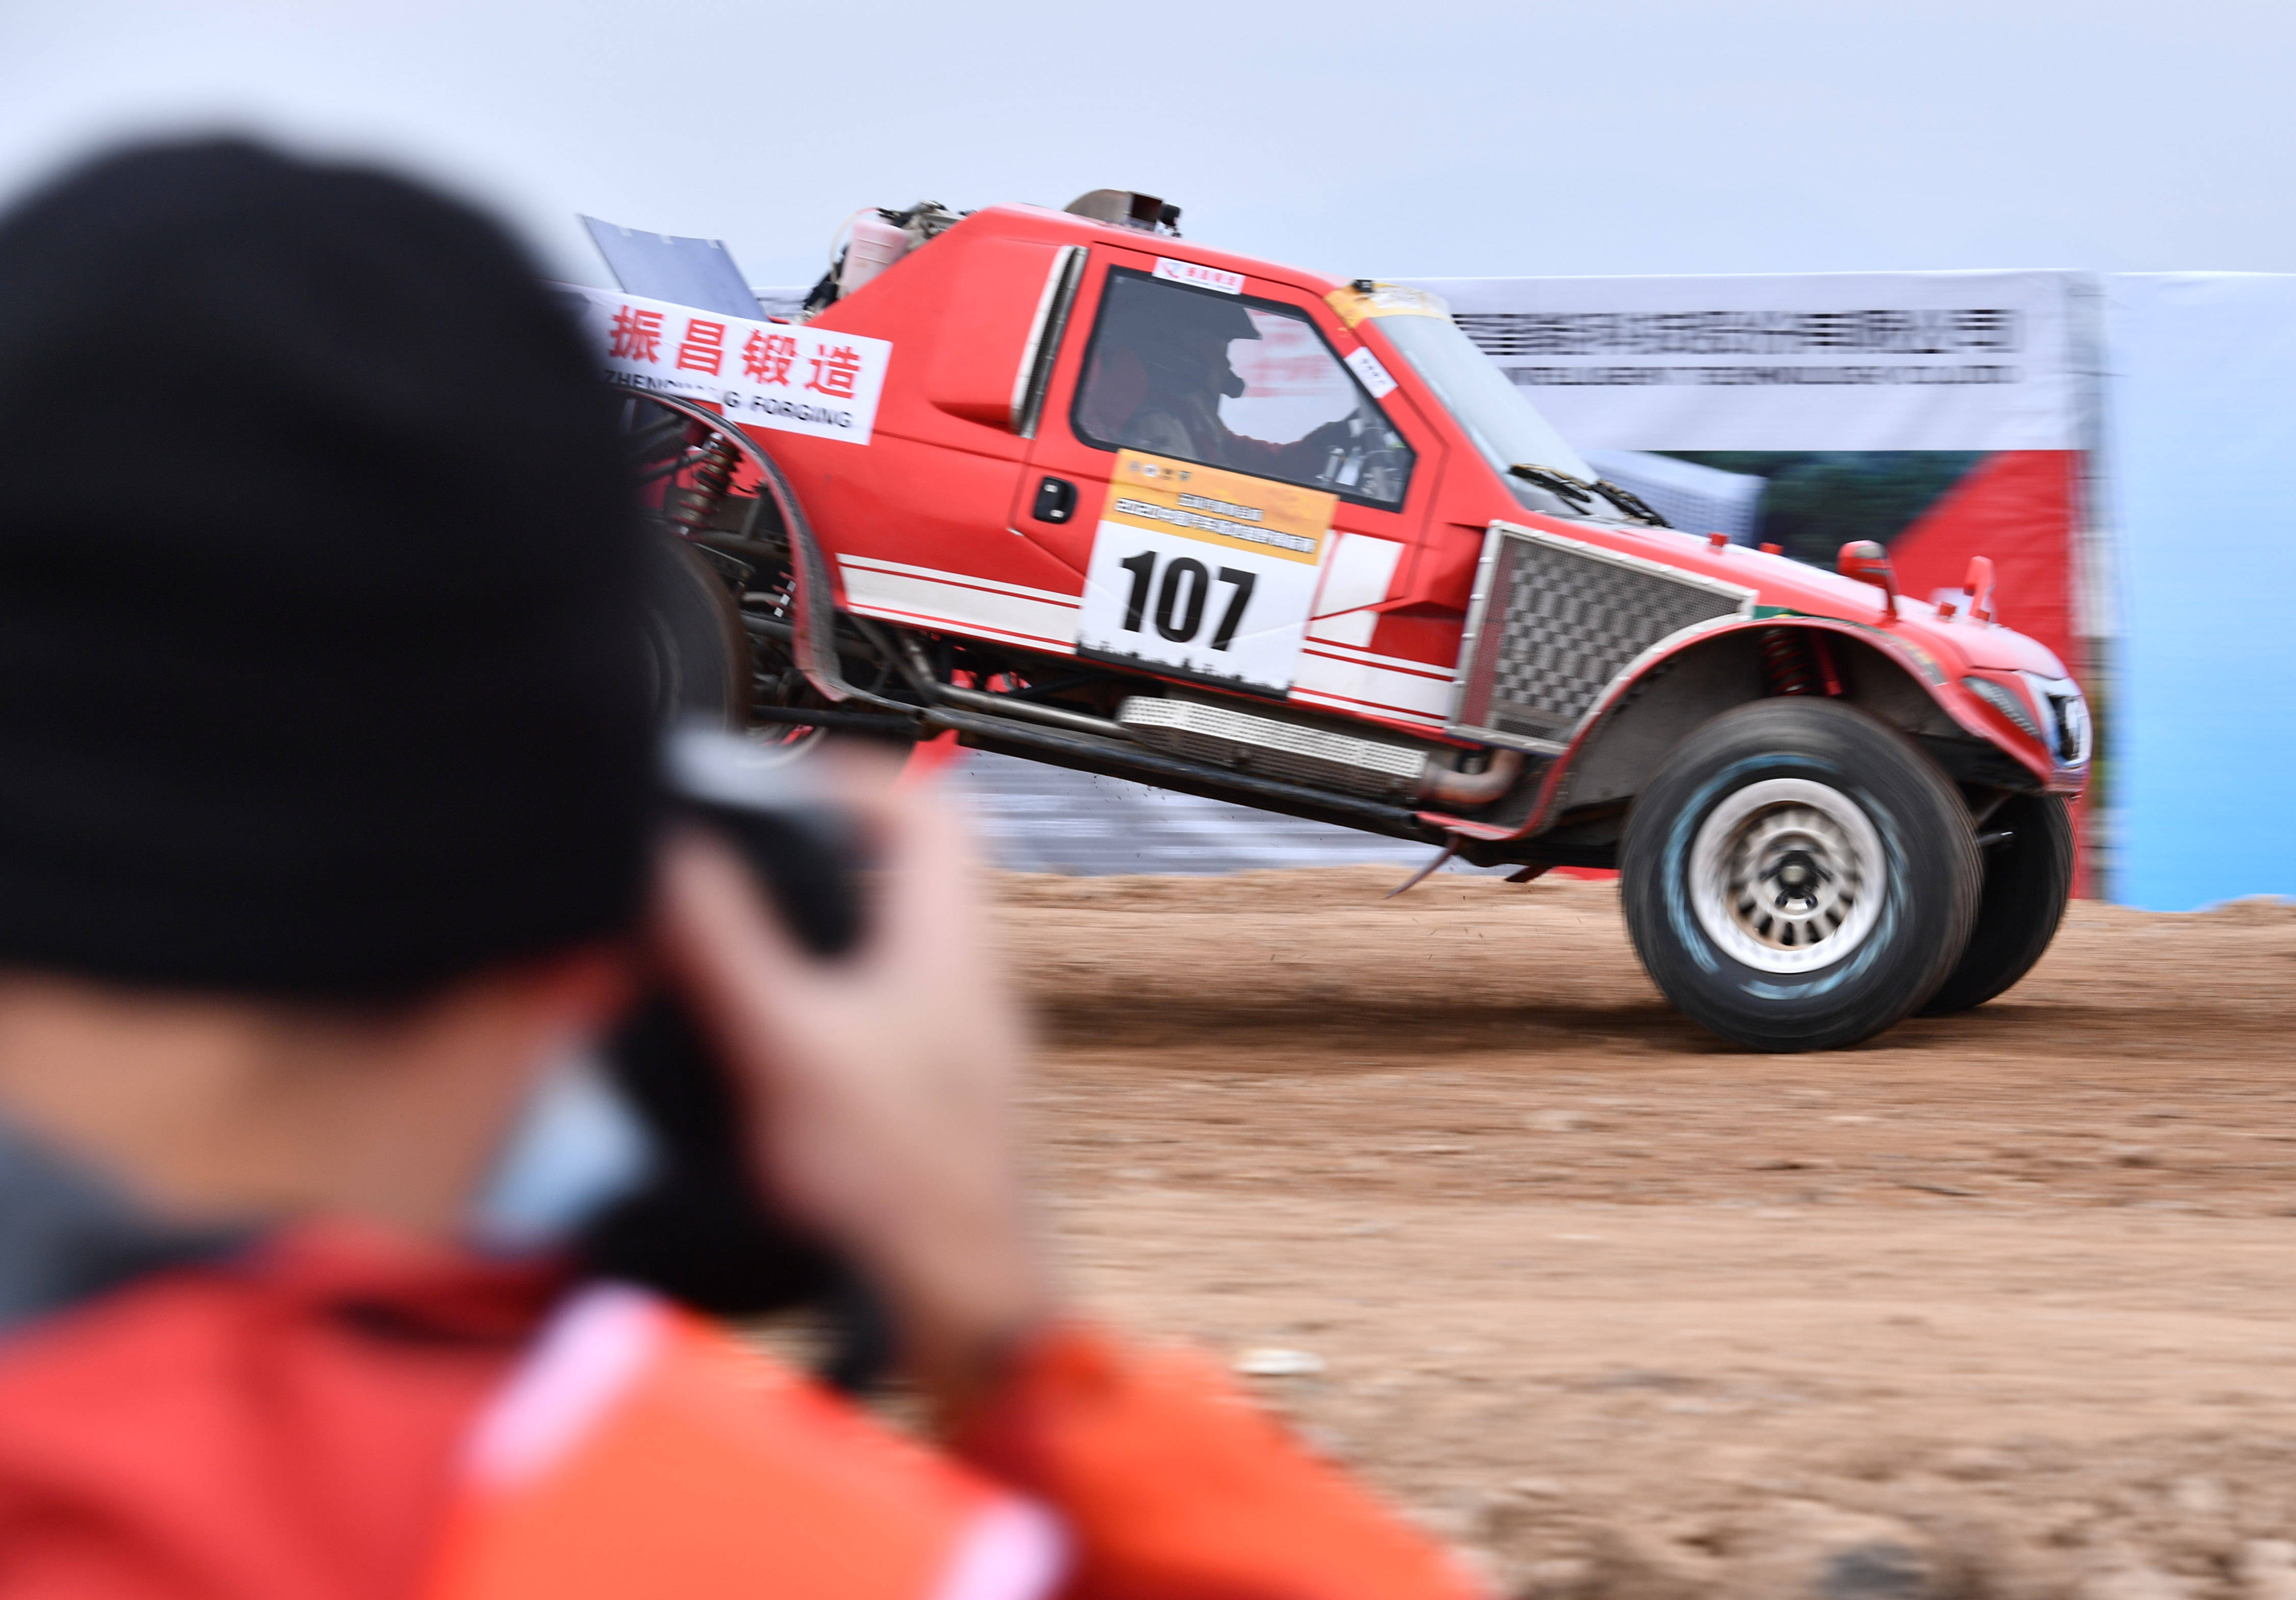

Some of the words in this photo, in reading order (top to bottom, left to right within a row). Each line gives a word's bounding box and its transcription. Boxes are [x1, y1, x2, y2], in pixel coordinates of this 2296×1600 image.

[609, 305, 862, 400] 振昌锻造
[751, 395, 853, 428] FORGING
[1119, 550, 1259, 652] 107
